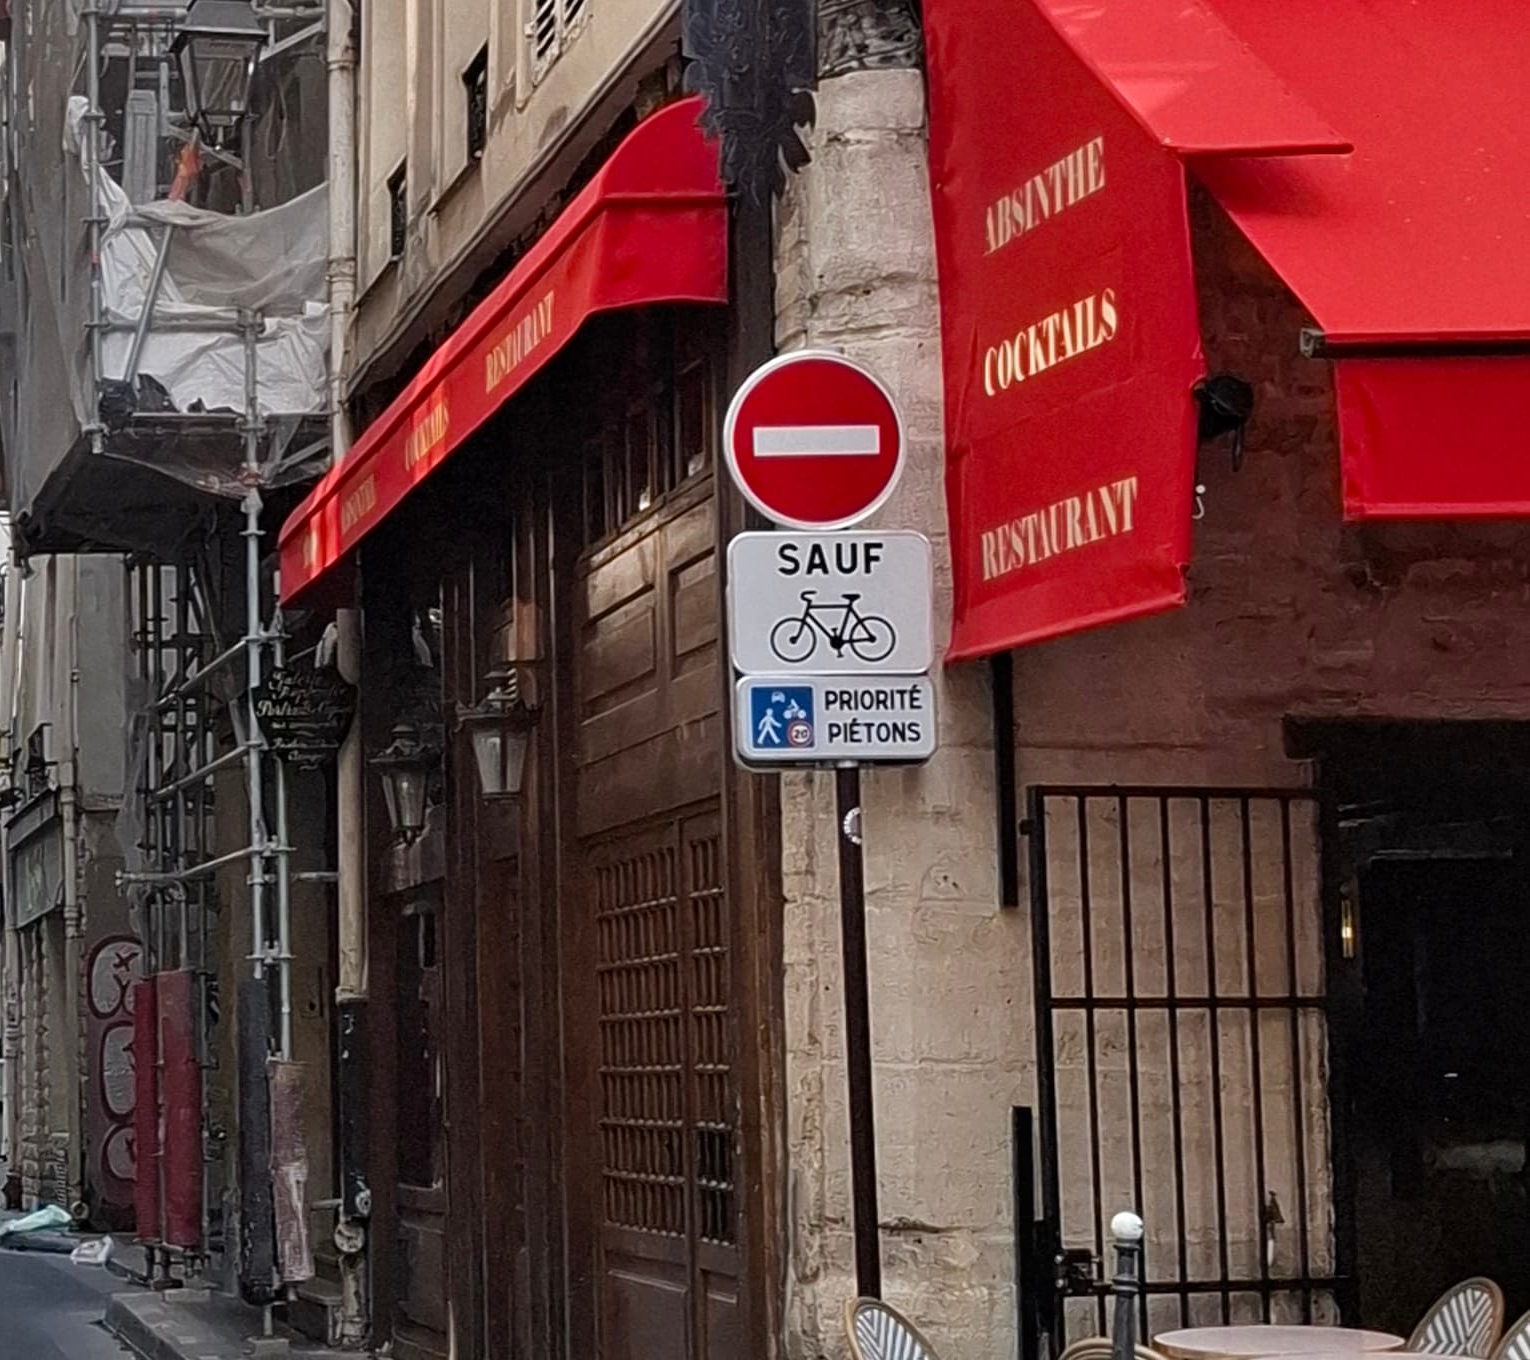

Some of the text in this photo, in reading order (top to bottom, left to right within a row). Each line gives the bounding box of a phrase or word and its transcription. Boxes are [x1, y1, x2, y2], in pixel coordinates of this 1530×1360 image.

[983, 136, 1106, 258] ABSINTHE
[983, 287, 1118, 397] COCKTAILS
[777, 542, 884, 576] SAUF
[981, 477, 1138, 582] RESTAURANT
[824, 684, 923, 711] PRIORITÉ
[828, 717, 922, 744] PIÉTONS
